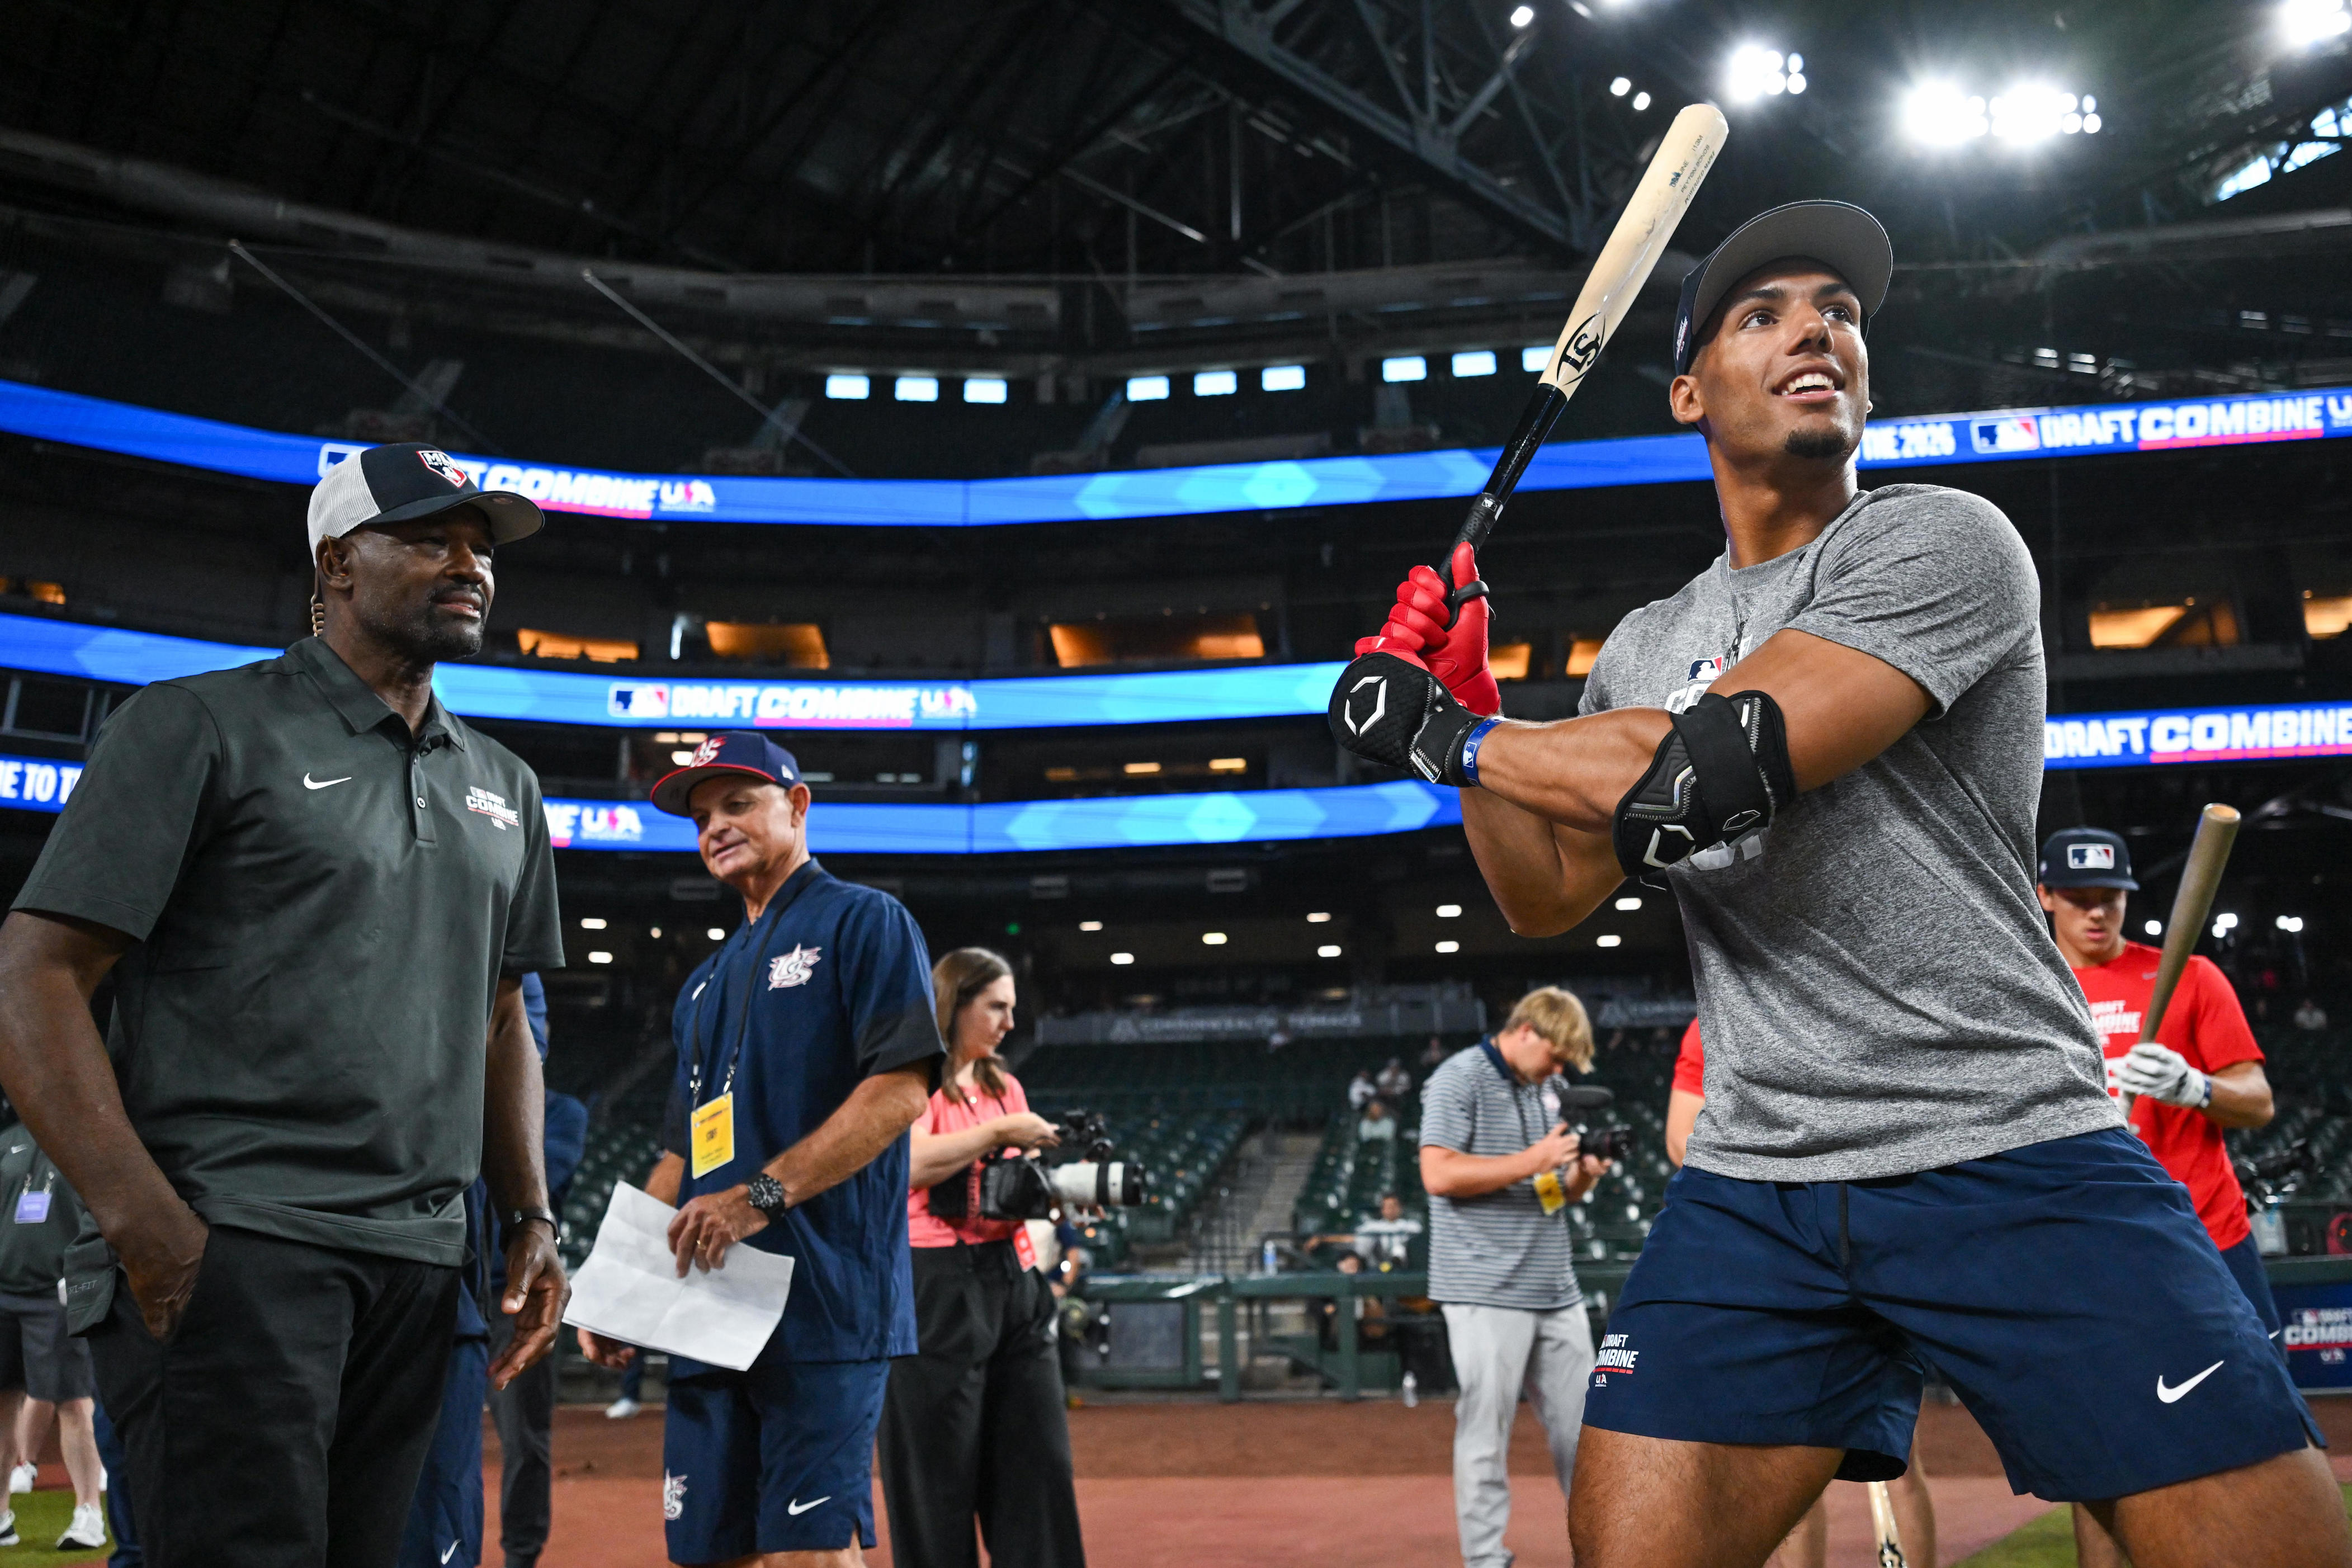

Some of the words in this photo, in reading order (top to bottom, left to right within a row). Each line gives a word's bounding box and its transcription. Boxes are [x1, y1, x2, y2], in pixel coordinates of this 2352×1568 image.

[1681, 167, 1697, 193] PEYTON
[1696, 144, 1709, 167] BONDS
[2041, 409, 2138, 447] DRAFT
[2138, 396, 2323, 441] COMBINE
[484, 464, 659, 511] COMBINE
[672, 686, 758, 718] DRAFT
[757, 687, 919, 719] COMBINE
[2044, 718, 2148, 758] DRAFT
[2150, 708, 2352, 752] COMBINE
[22, 763, 56, 802] TO
[466, 795, 518, 823] COMBINE
[1595, 1349, 1639, 1368] OMBINE
[1605, 1334, 1629, 1348] DRAFT
